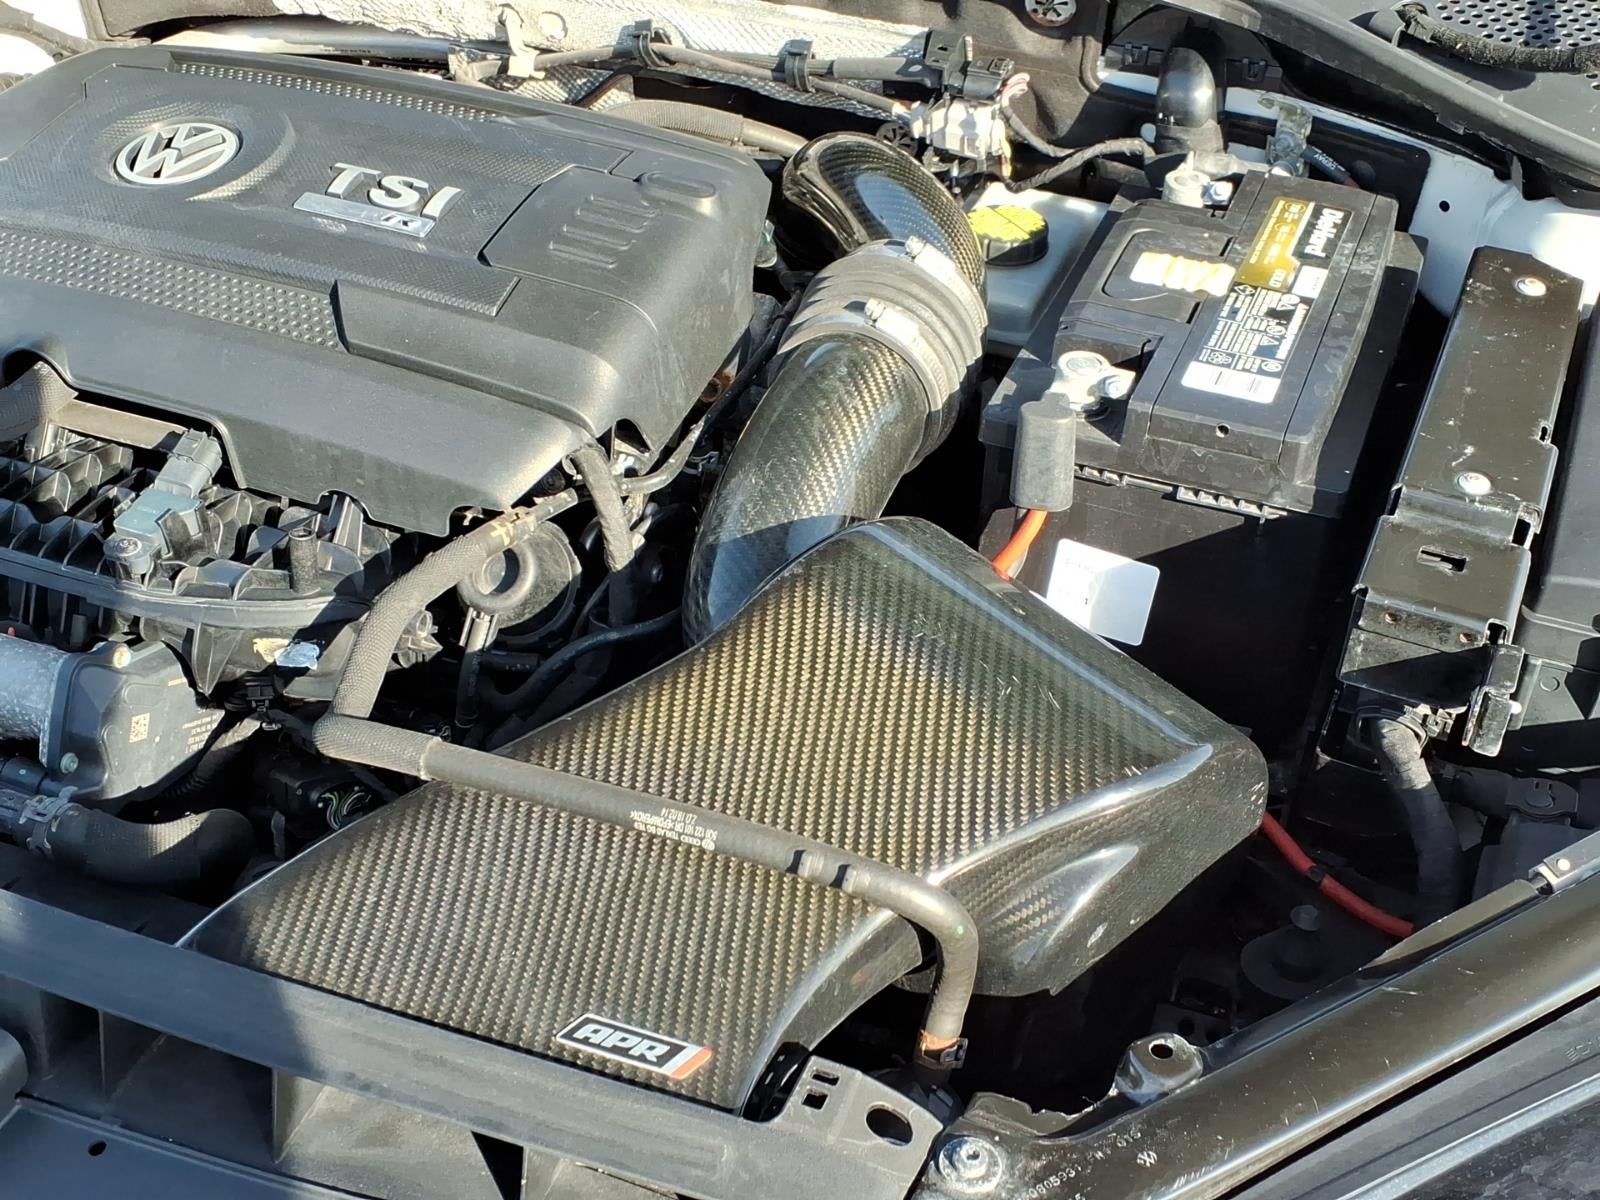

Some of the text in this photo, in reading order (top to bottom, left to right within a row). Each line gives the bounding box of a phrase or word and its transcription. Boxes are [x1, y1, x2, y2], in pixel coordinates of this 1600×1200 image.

[325, 162, 462, 220] TSI
[1303, 207, 1345, 258] DieHard
[572, 1023, 671, 1063] APR
